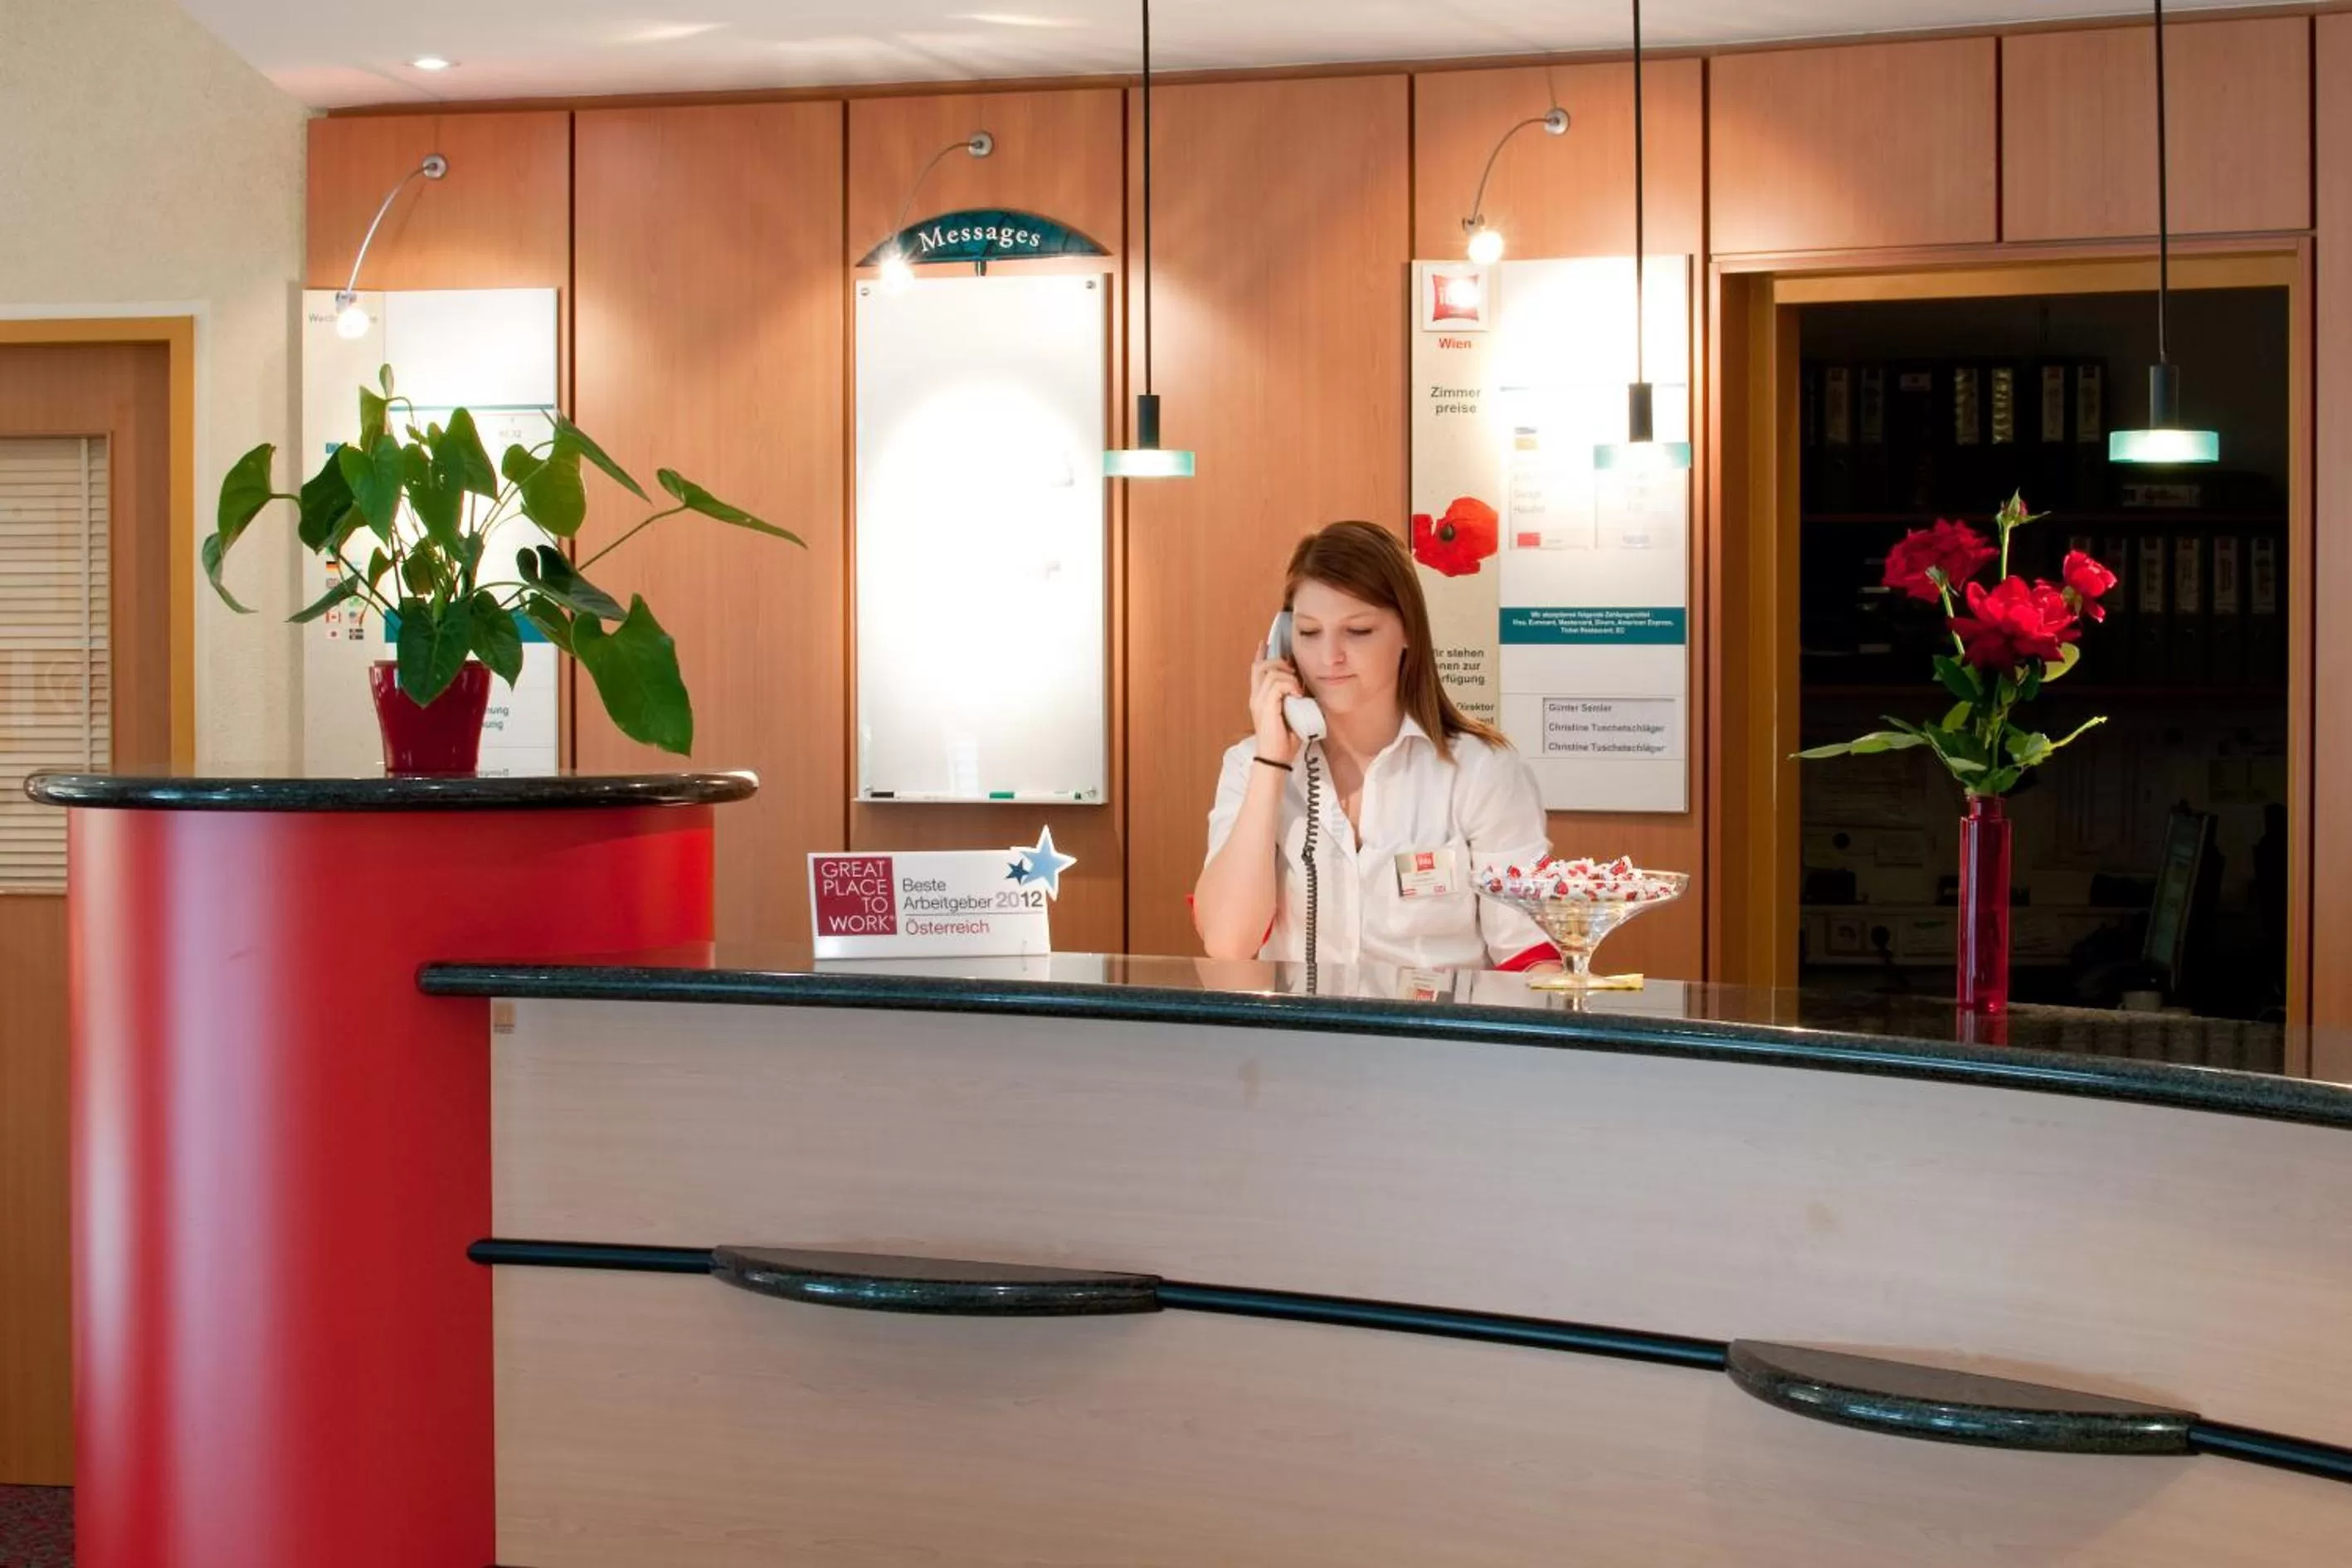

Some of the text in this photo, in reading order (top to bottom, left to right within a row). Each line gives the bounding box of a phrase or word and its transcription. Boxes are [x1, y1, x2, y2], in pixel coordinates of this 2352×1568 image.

[918, 226, 1040, 252] Messages
[1439, 338, 1472, 348] Wien
[1430, 386, 1480, 398] Zimmer
[1435, 402, 1477, 416] preise
[1447, 647, 1484, 658] stehen
[1442, 674, 1485, 686] rfügung
[821, 859, 885, 878] GREAT
[823, 879, 889, 896] PLACE
[902, 878, 947, 893] Beste
[861, 896, 889, 913] TO
[903, 890, 1044, 912] Arbeitgeber 2012
[829, 914, 890, 933] WORK
[905, 918, 990, 935] Österreich
